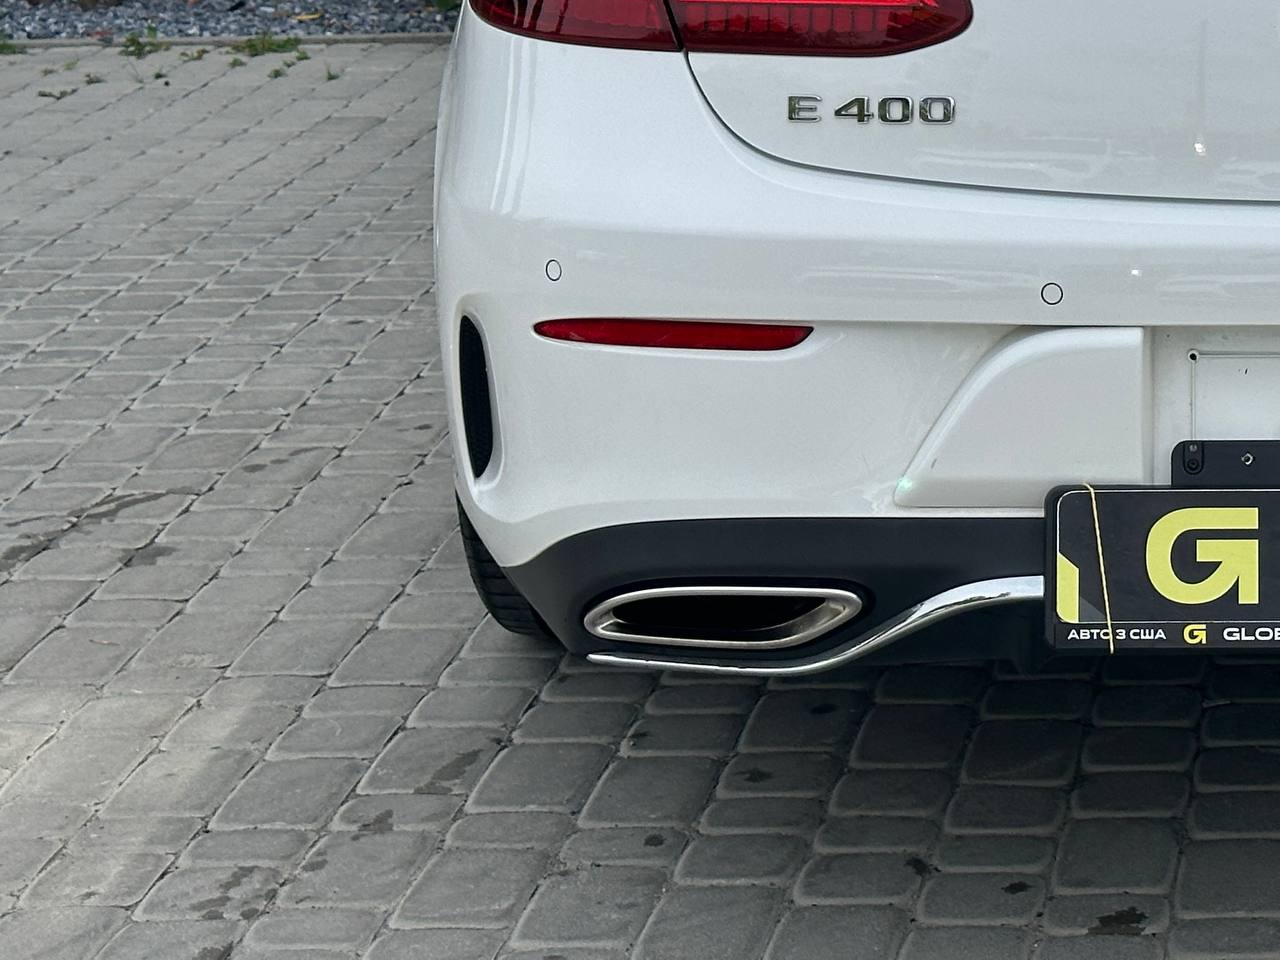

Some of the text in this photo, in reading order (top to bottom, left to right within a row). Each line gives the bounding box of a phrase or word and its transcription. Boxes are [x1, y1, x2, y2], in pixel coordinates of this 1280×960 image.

[787, 95, 956, 125] E 400
[1129, 628, 1167, 640] США
